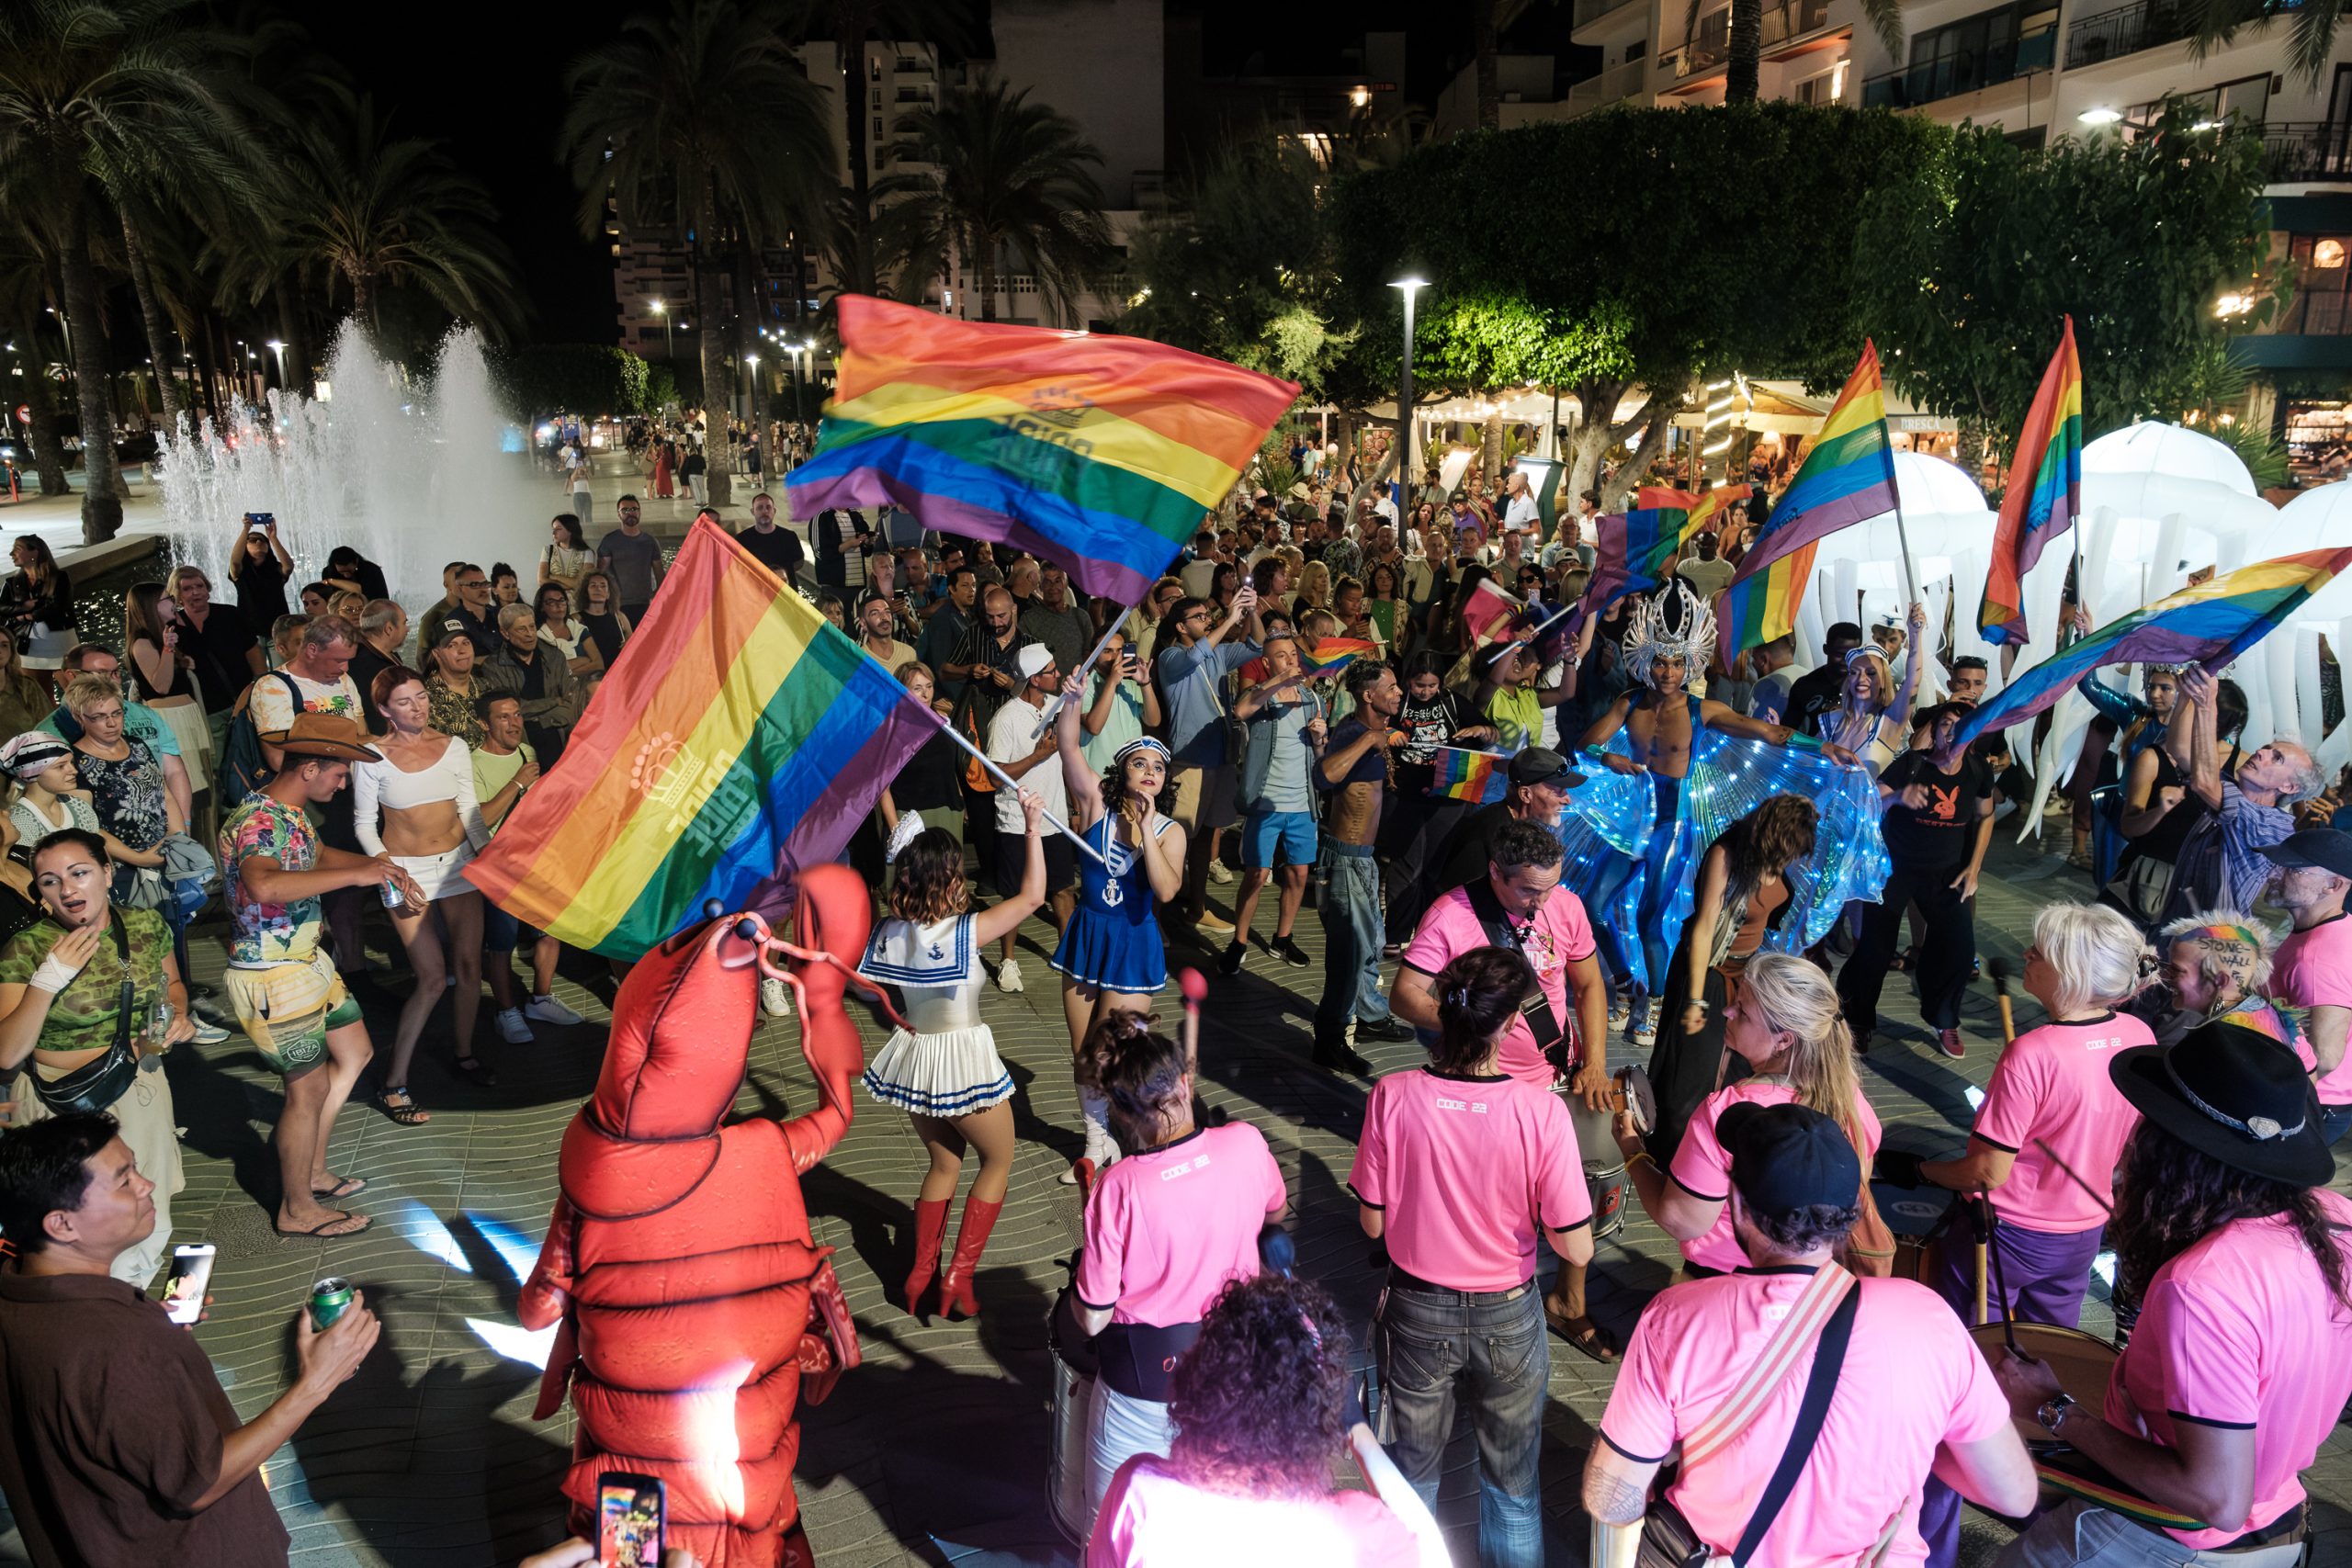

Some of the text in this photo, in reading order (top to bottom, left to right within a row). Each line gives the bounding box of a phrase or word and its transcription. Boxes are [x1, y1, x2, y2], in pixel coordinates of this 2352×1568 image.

[1901, 418, 1940, 430] BRESCA
[2219, 954, 2251, 967] WALL
[2086, 1037, 2122, 1050] CODE 22
[292, 1044, 318, 1057] IBIZA
[1436, 1098, 1467, 1111] CODE
[1161, 1154, 1211, 1181] CODE 22
